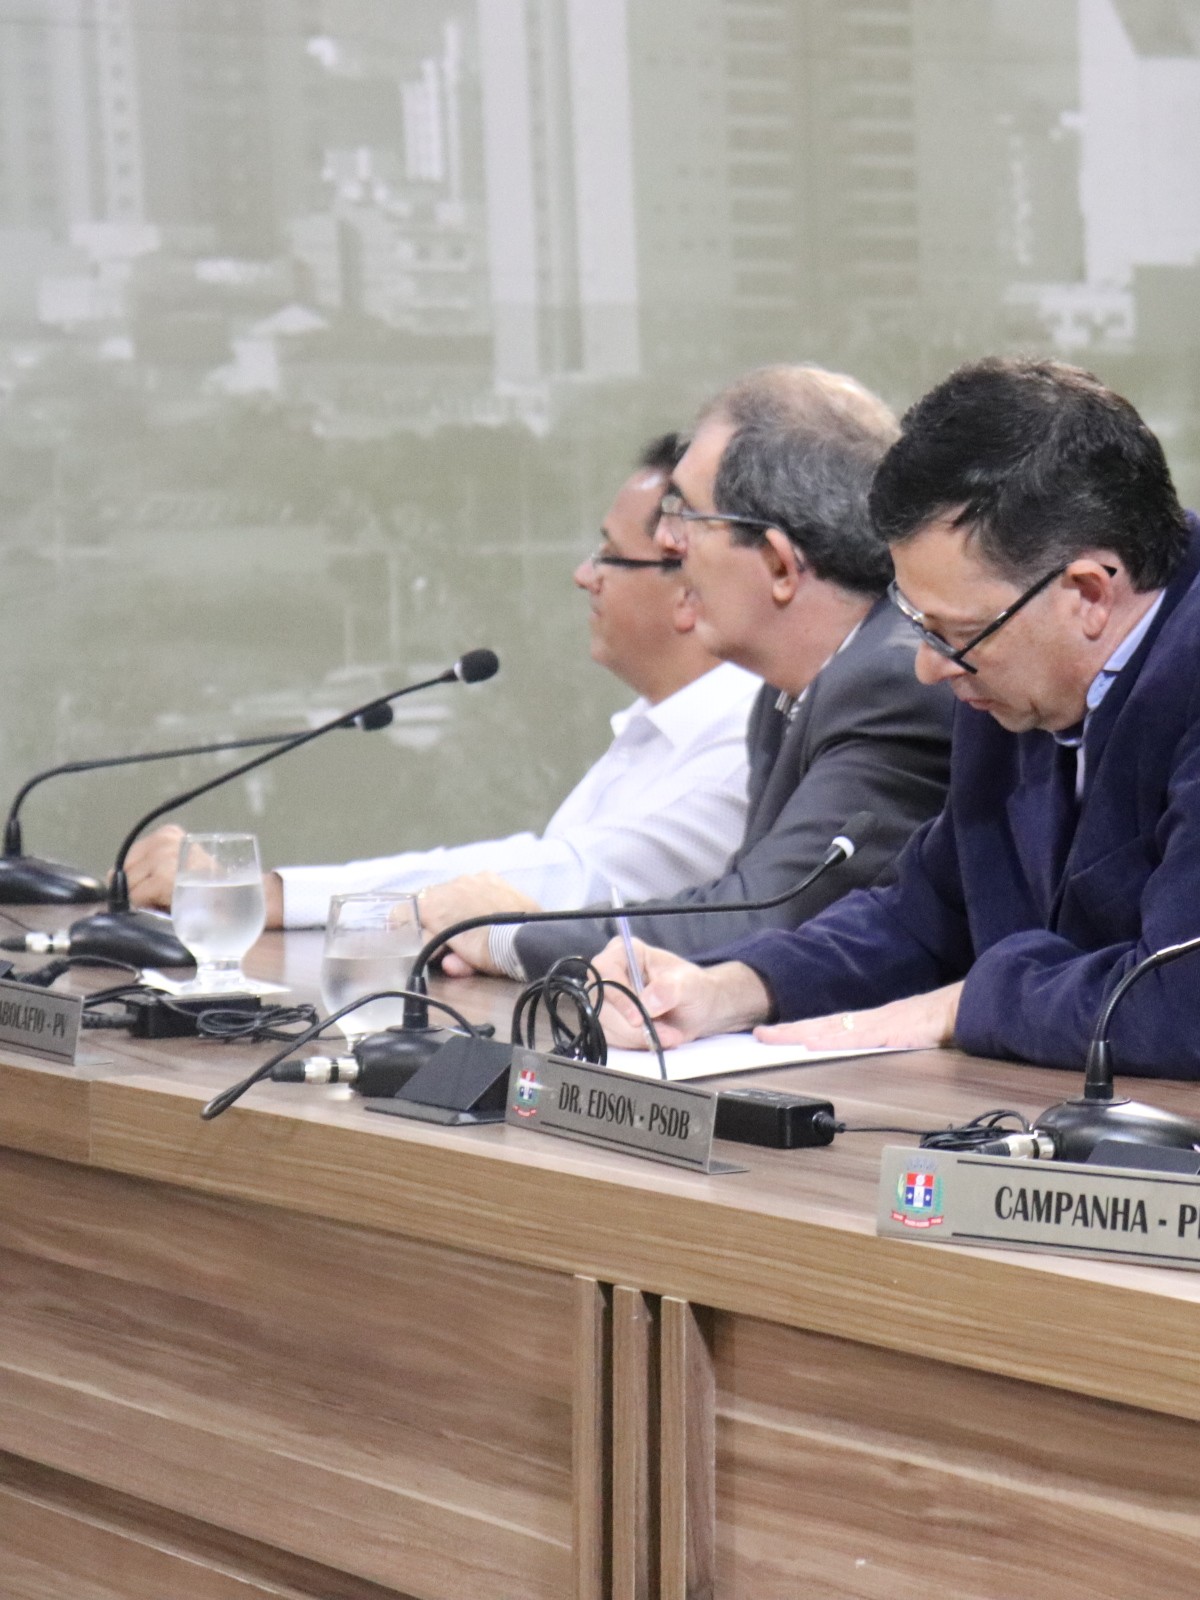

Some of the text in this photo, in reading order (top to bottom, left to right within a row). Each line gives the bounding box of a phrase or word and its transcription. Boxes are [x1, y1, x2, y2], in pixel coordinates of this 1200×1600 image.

[53, 1012, 69, 1038] PV
[559, 1082, 582, 1114] DR.
[587, 1089, 637, 1127] EDSON
[648, 1103, 690, 1140] PSDB
[994, 1186, 1148, 1234] CAMPANHA
